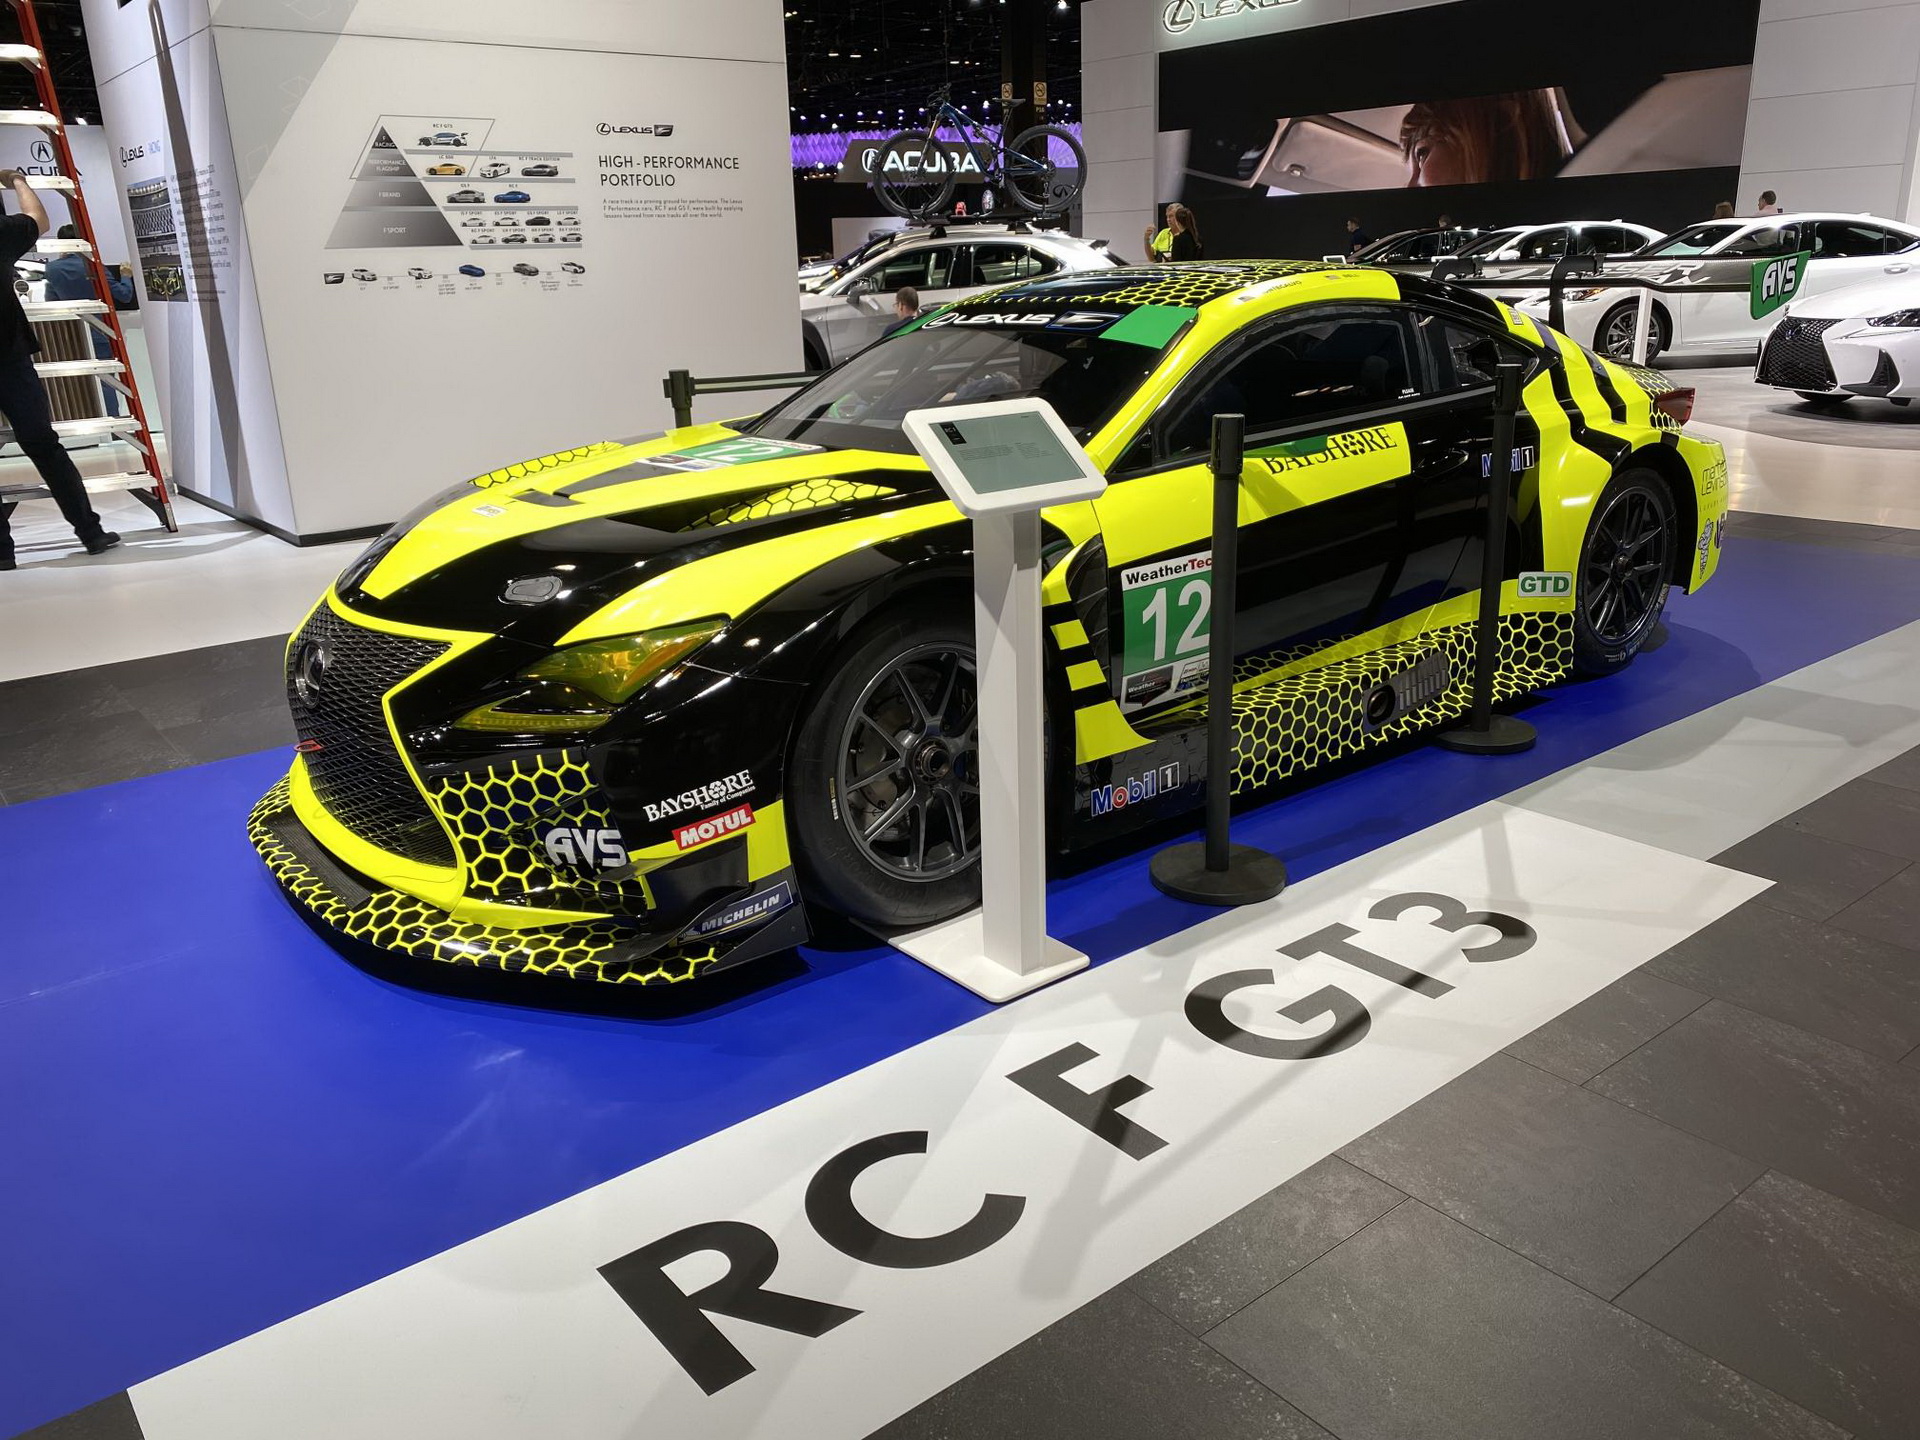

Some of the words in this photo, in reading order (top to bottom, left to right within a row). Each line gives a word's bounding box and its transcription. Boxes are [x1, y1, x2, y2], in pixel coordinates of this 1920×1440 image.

[1200, 0, 1299, 19] LEX
[612, 126, 653, 134] LEXUS
[598, 155, 633, 168] HIGH
[643, 155, 740, 170] PERFORMANCE
[600, 173, 676, 187] PORTFOLIO
[1762, 257, 1798, 305] AVS
[953, 312, 1056, 325] LEXUS
[694, 442, 784, 463] 12
[1126, 556, 1213, 586] WeatherTec
[1520, 576, 1570, 593] GTD
[1142, 578, 1212, 662] 12
[642, 769, 754, 823] BAYSHORE
[700, 799, 720, 811] Family
[719, 796, 727, 804] of
[726, 785, 757, 801] Companies
[1090, 769, 1157, 818] Mobil
[680, 808, 752, 848] MOTUL
[545, 827, 627, 870] AVS
[701, 893, 780, 932] MICHELIN
[596, 1129, 1027, 1396] RC
[1005, 1040, 1170, 1162] F
[1183, 890, 1538, 1061] GT3
